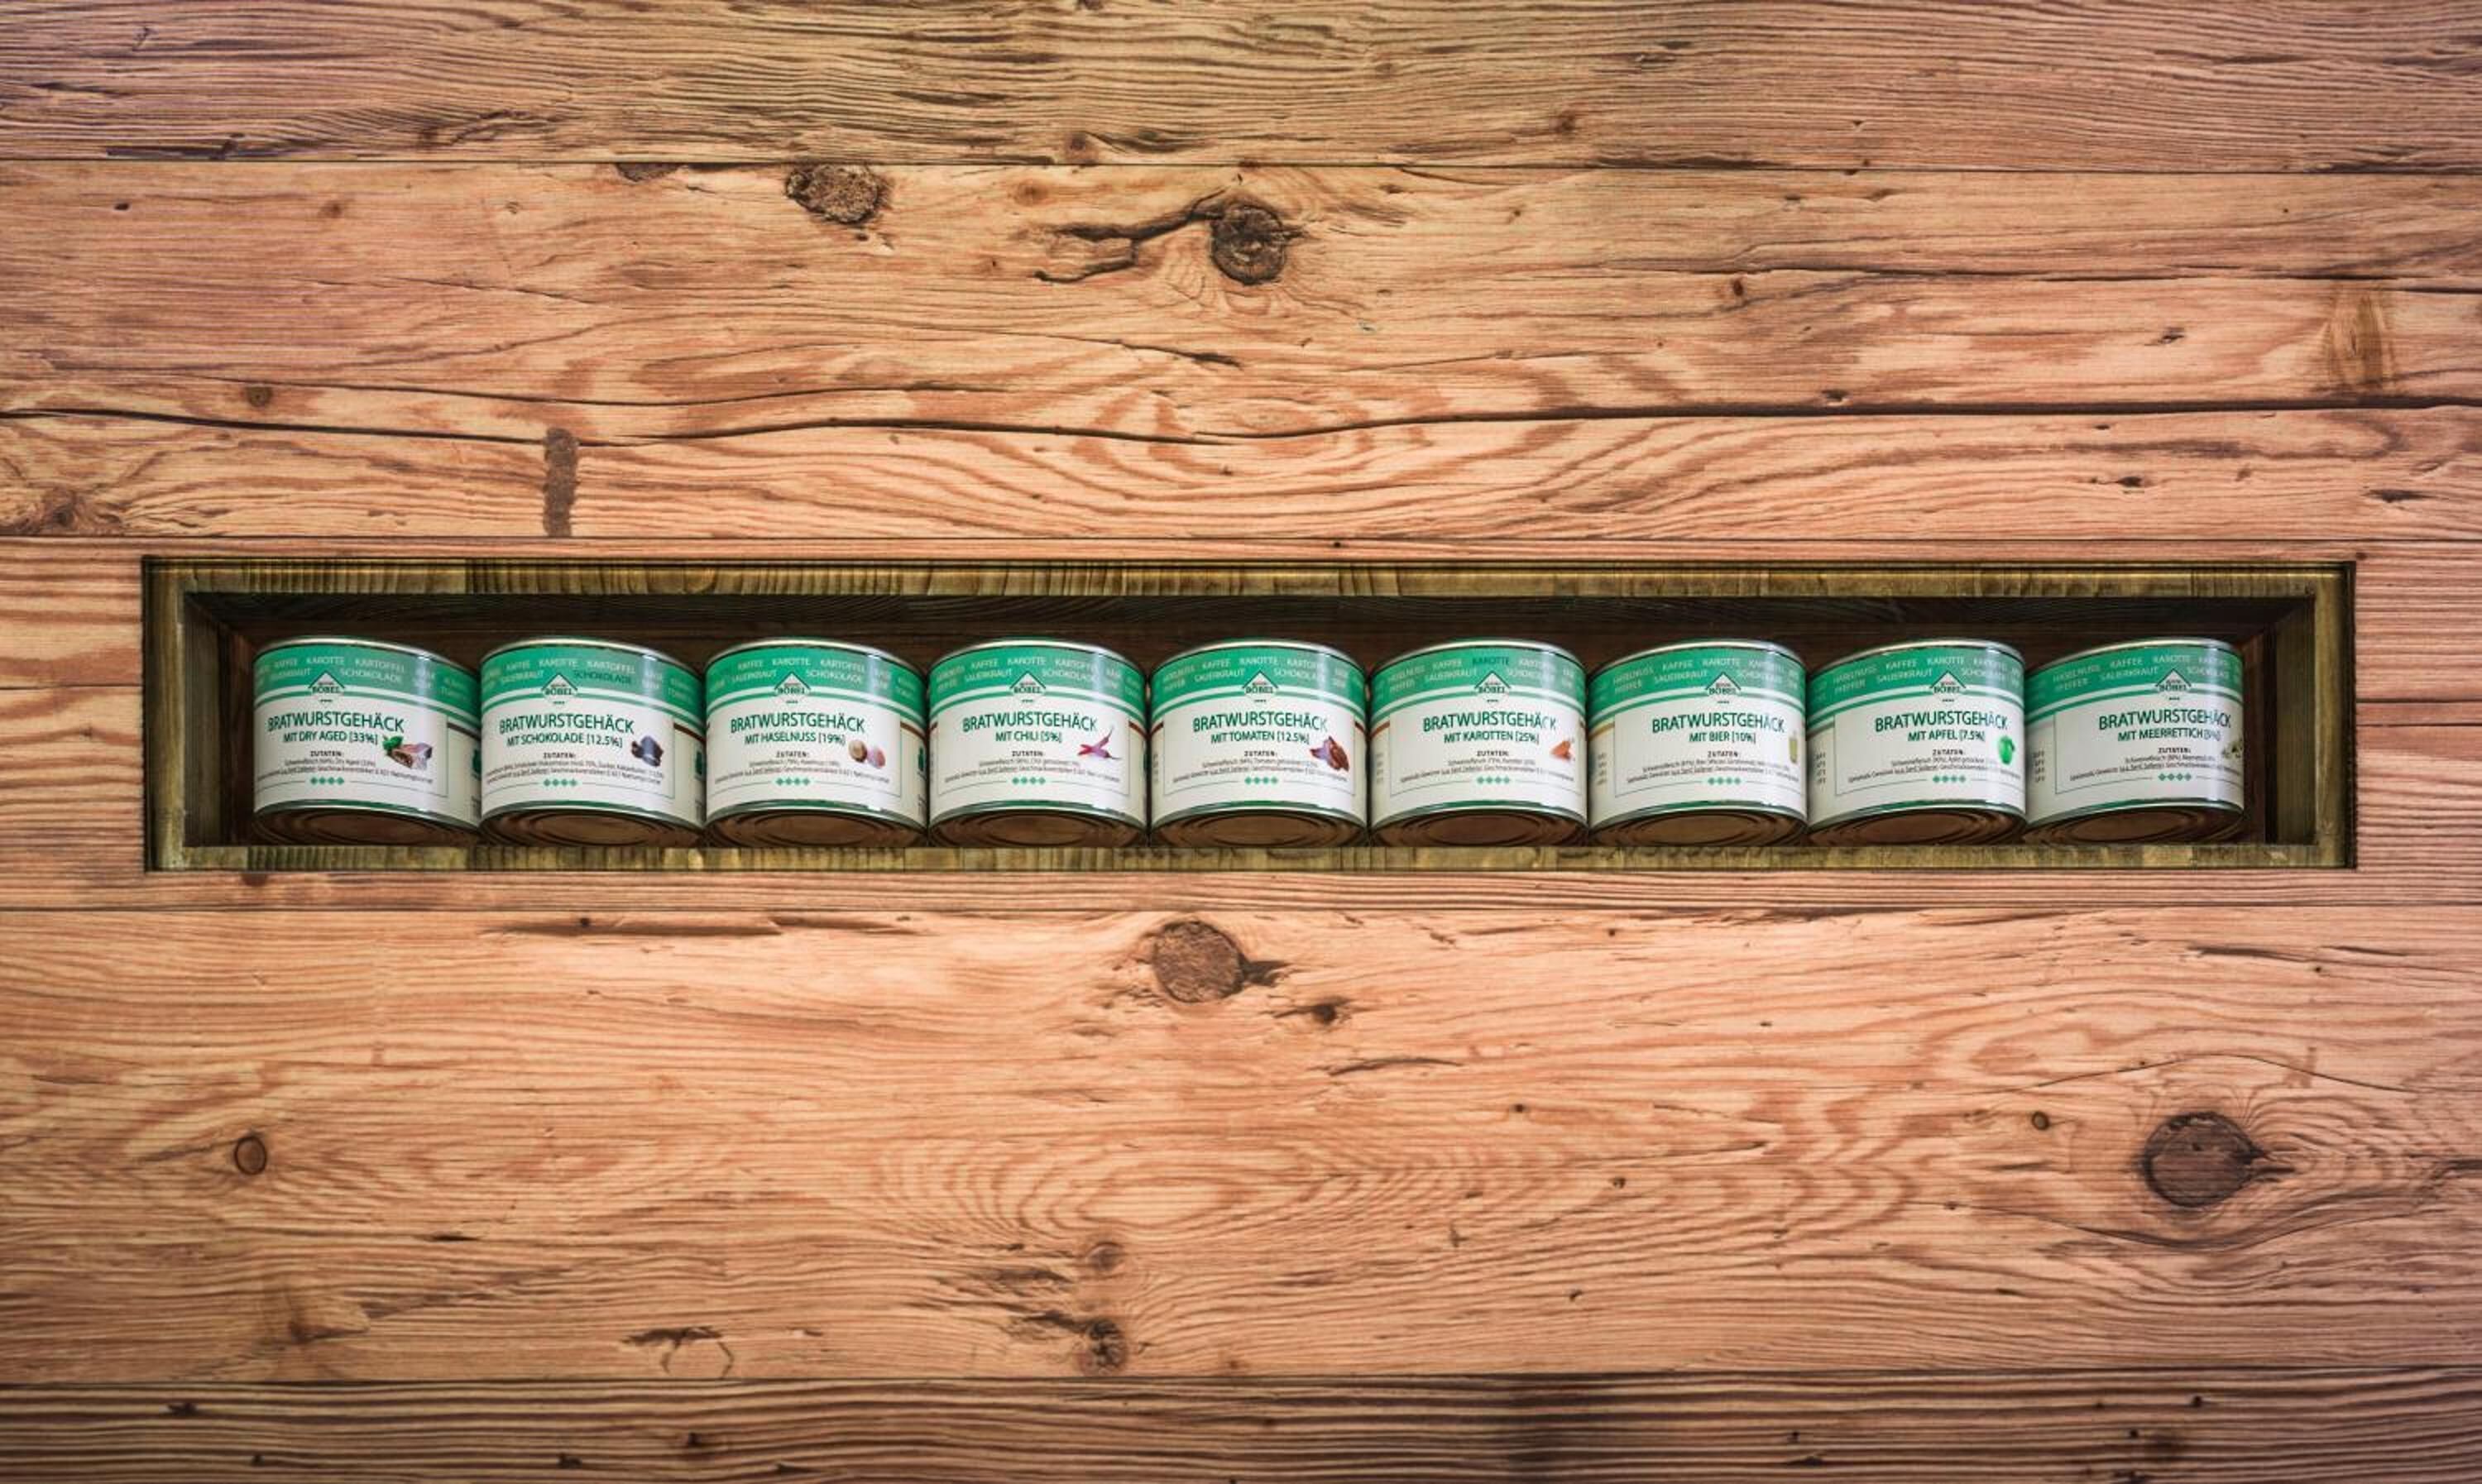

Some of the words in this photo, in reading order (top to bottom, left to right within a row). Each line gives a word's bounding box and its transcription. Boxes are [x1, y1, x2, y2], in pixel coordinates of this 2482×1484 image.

[1473, 657, 1509, 665] KAROTTE
[340, 668, 402, 683] SCHOKOLADE
[575, 672, 632, 685] SCHOKOLADE
[267, 711, 405, 733] BRATWURSTGEHÄCK
[500, 713, 635, 734] BRATWURSTGEHÄCK
[731, 712, 865, 733] BRATWURSTGEHÄCK
[962, 711, 1098, 733] BRATWURSTGEHÄCK
[1193, 711, 1328, 733] BRATWURSTGEHÄCK
[1423, 711, 1557, 733] BRATWURSTGEHÄCK
[1652, 712, 1785, 733] BRATWURSTGEHÄCK
[1876, 711, 2009, 733] BRATWURSTGEHÄCK
[2099, 709, 2231, 730] BRATWURSTGEHÄCK
[283, 733, 297, 743] MIT
[299, 732, 317, 742] DRY
[320, 731, 347, 741] AGED
[507, 735, 520, 746] MIT
[521, 733, 584, 744] SCHOKOLADE
[745, 734, 759, 744] MIT
[995, 730, 1013, 741] MIT
[1014, 730, 1038, 741] CHILI
[1210, 732, 1226, 744] MIT
[1227, 731, 1275, 742] TOMATEN
[1445, 733, 1461, 744] MIT
[1463, 730, 1513, 742] KAROTTEN
[1689, 731, 1707, 743] MIT
[1709, 731, 1730, 742] BIER
[1908, 731, 1925, 742] MIT
[1929, 730, 1957, 741] APFEL
[2118, 730, 2137, 741] MIT
[2139, 728, 2202, 740] MEERRETTICH
